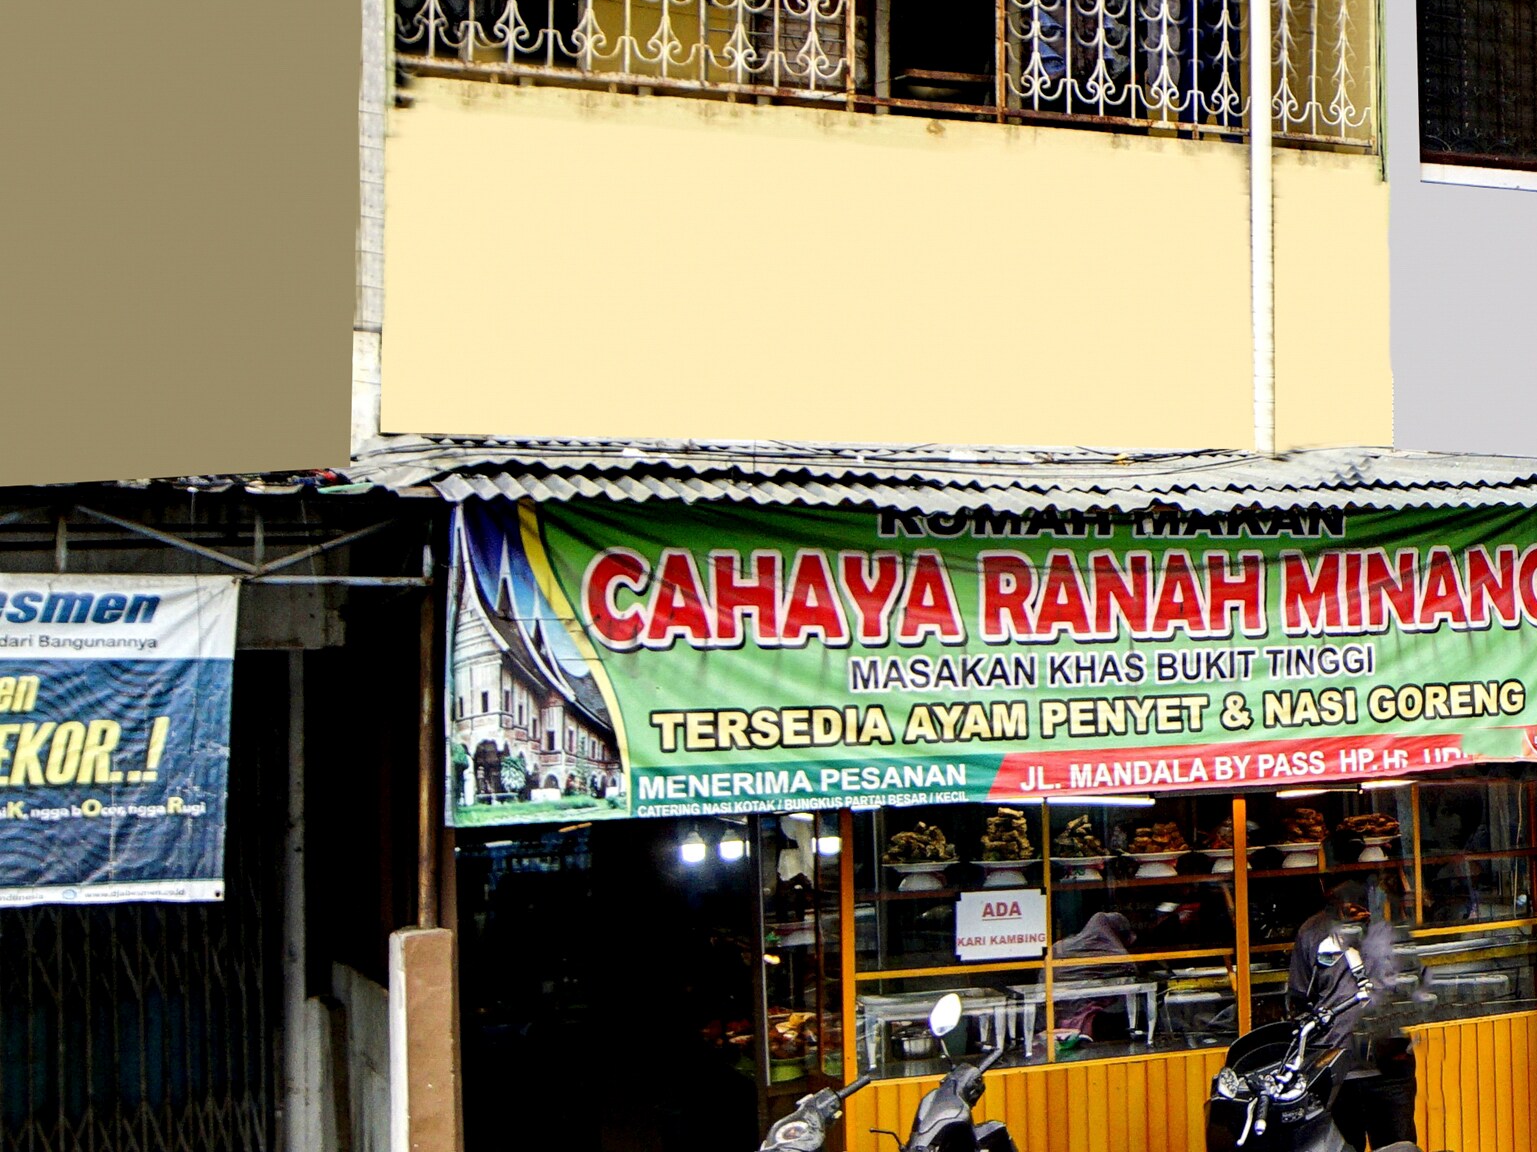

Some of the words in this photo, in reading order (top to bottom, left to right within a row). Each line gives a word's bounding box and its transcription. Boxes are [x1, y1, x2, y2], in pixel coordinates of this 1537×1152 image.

[582, 547, 968, 652] CAHAYA
[978, 548, 1268, 646] RANAH
[39, 636, 158, 650] Bangunannya
[850, 654, 1036, 691] MASAKAN
[1050, 653, 1145, 686] KHAS
[1158, 650, 1255, 682] BUKIT
[1267, 646, 1374, 678] TINGGI
[650, 705, 894, 753] TERSEDIA
[904, 700, 1028, 745] AYAM
[1041, 694, 1209, 739] PENYET
[1221, 692, 1253, 730] &
[1263, 687, 1359, 729] NASI
[1367, 679, 1525, 724] GORENG
[639, 770, 813, 799] MENERIMA
[821, 764, 966, 792] PESANAN
[1020, 765, 1061, 791] JL.
[1070, 757, 1206, 788] MANDALA
[1215, 754, 1248, 780] BY
[1258, 750, 1326, 777] PASS
[167, 797, 206, 816] Rugi
[637, 803, 700, 818] CATERING
[703, 802, 732, 815] NASI
[734, 800, 776, 813] KOTAK
[784, 797, 843, 811] BUNGKUS
[845, 795, 886, 808] PARTAI
[888, 793, 928, 806] BESAR
[936, 790, 969, 803] KECIL
[982, 901, 1022, 918] ADA
[957, 936, 986, 946] KARI
[990, 933, 1046, 945] KAMBING
